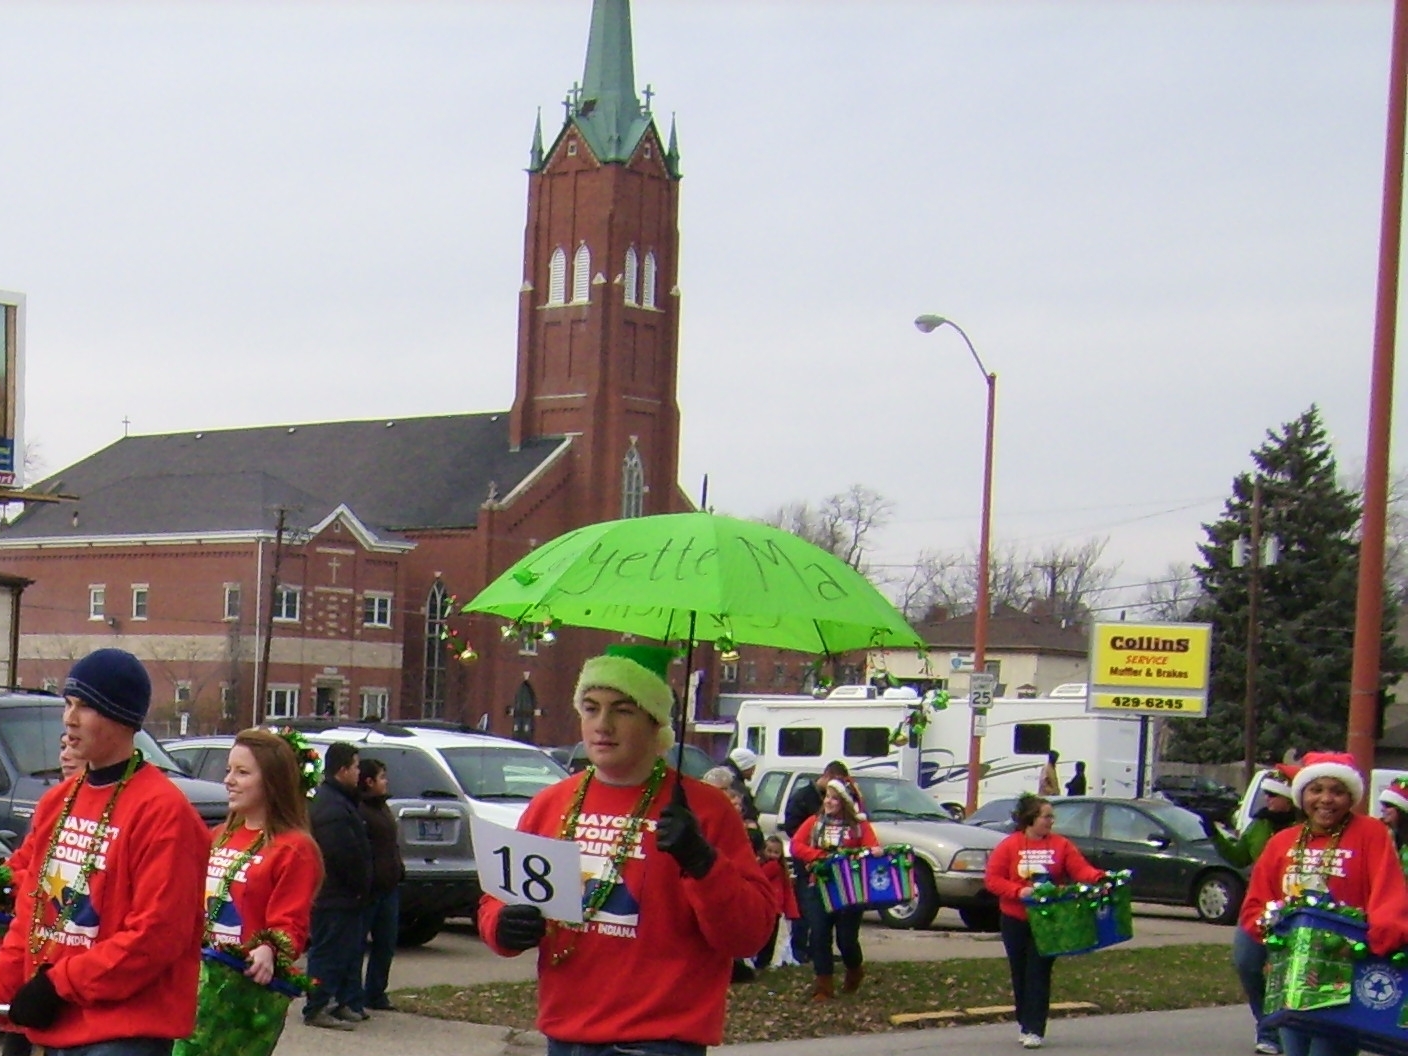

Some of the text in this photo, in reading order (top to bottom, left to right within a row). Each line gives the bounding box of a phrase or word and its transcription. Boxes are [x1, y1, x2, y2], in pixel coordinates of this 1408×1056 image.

[1126, 655, 1168, 665] SERVICE
[1110, 667, 1188, 678] Muffler & Brakes
[972, 691, 991, 705] 25
[1112, 697, 1184, 709] 429-6245
[493, 845, 554, 903] 18
[598, 924, 637, 939] INDIANA
